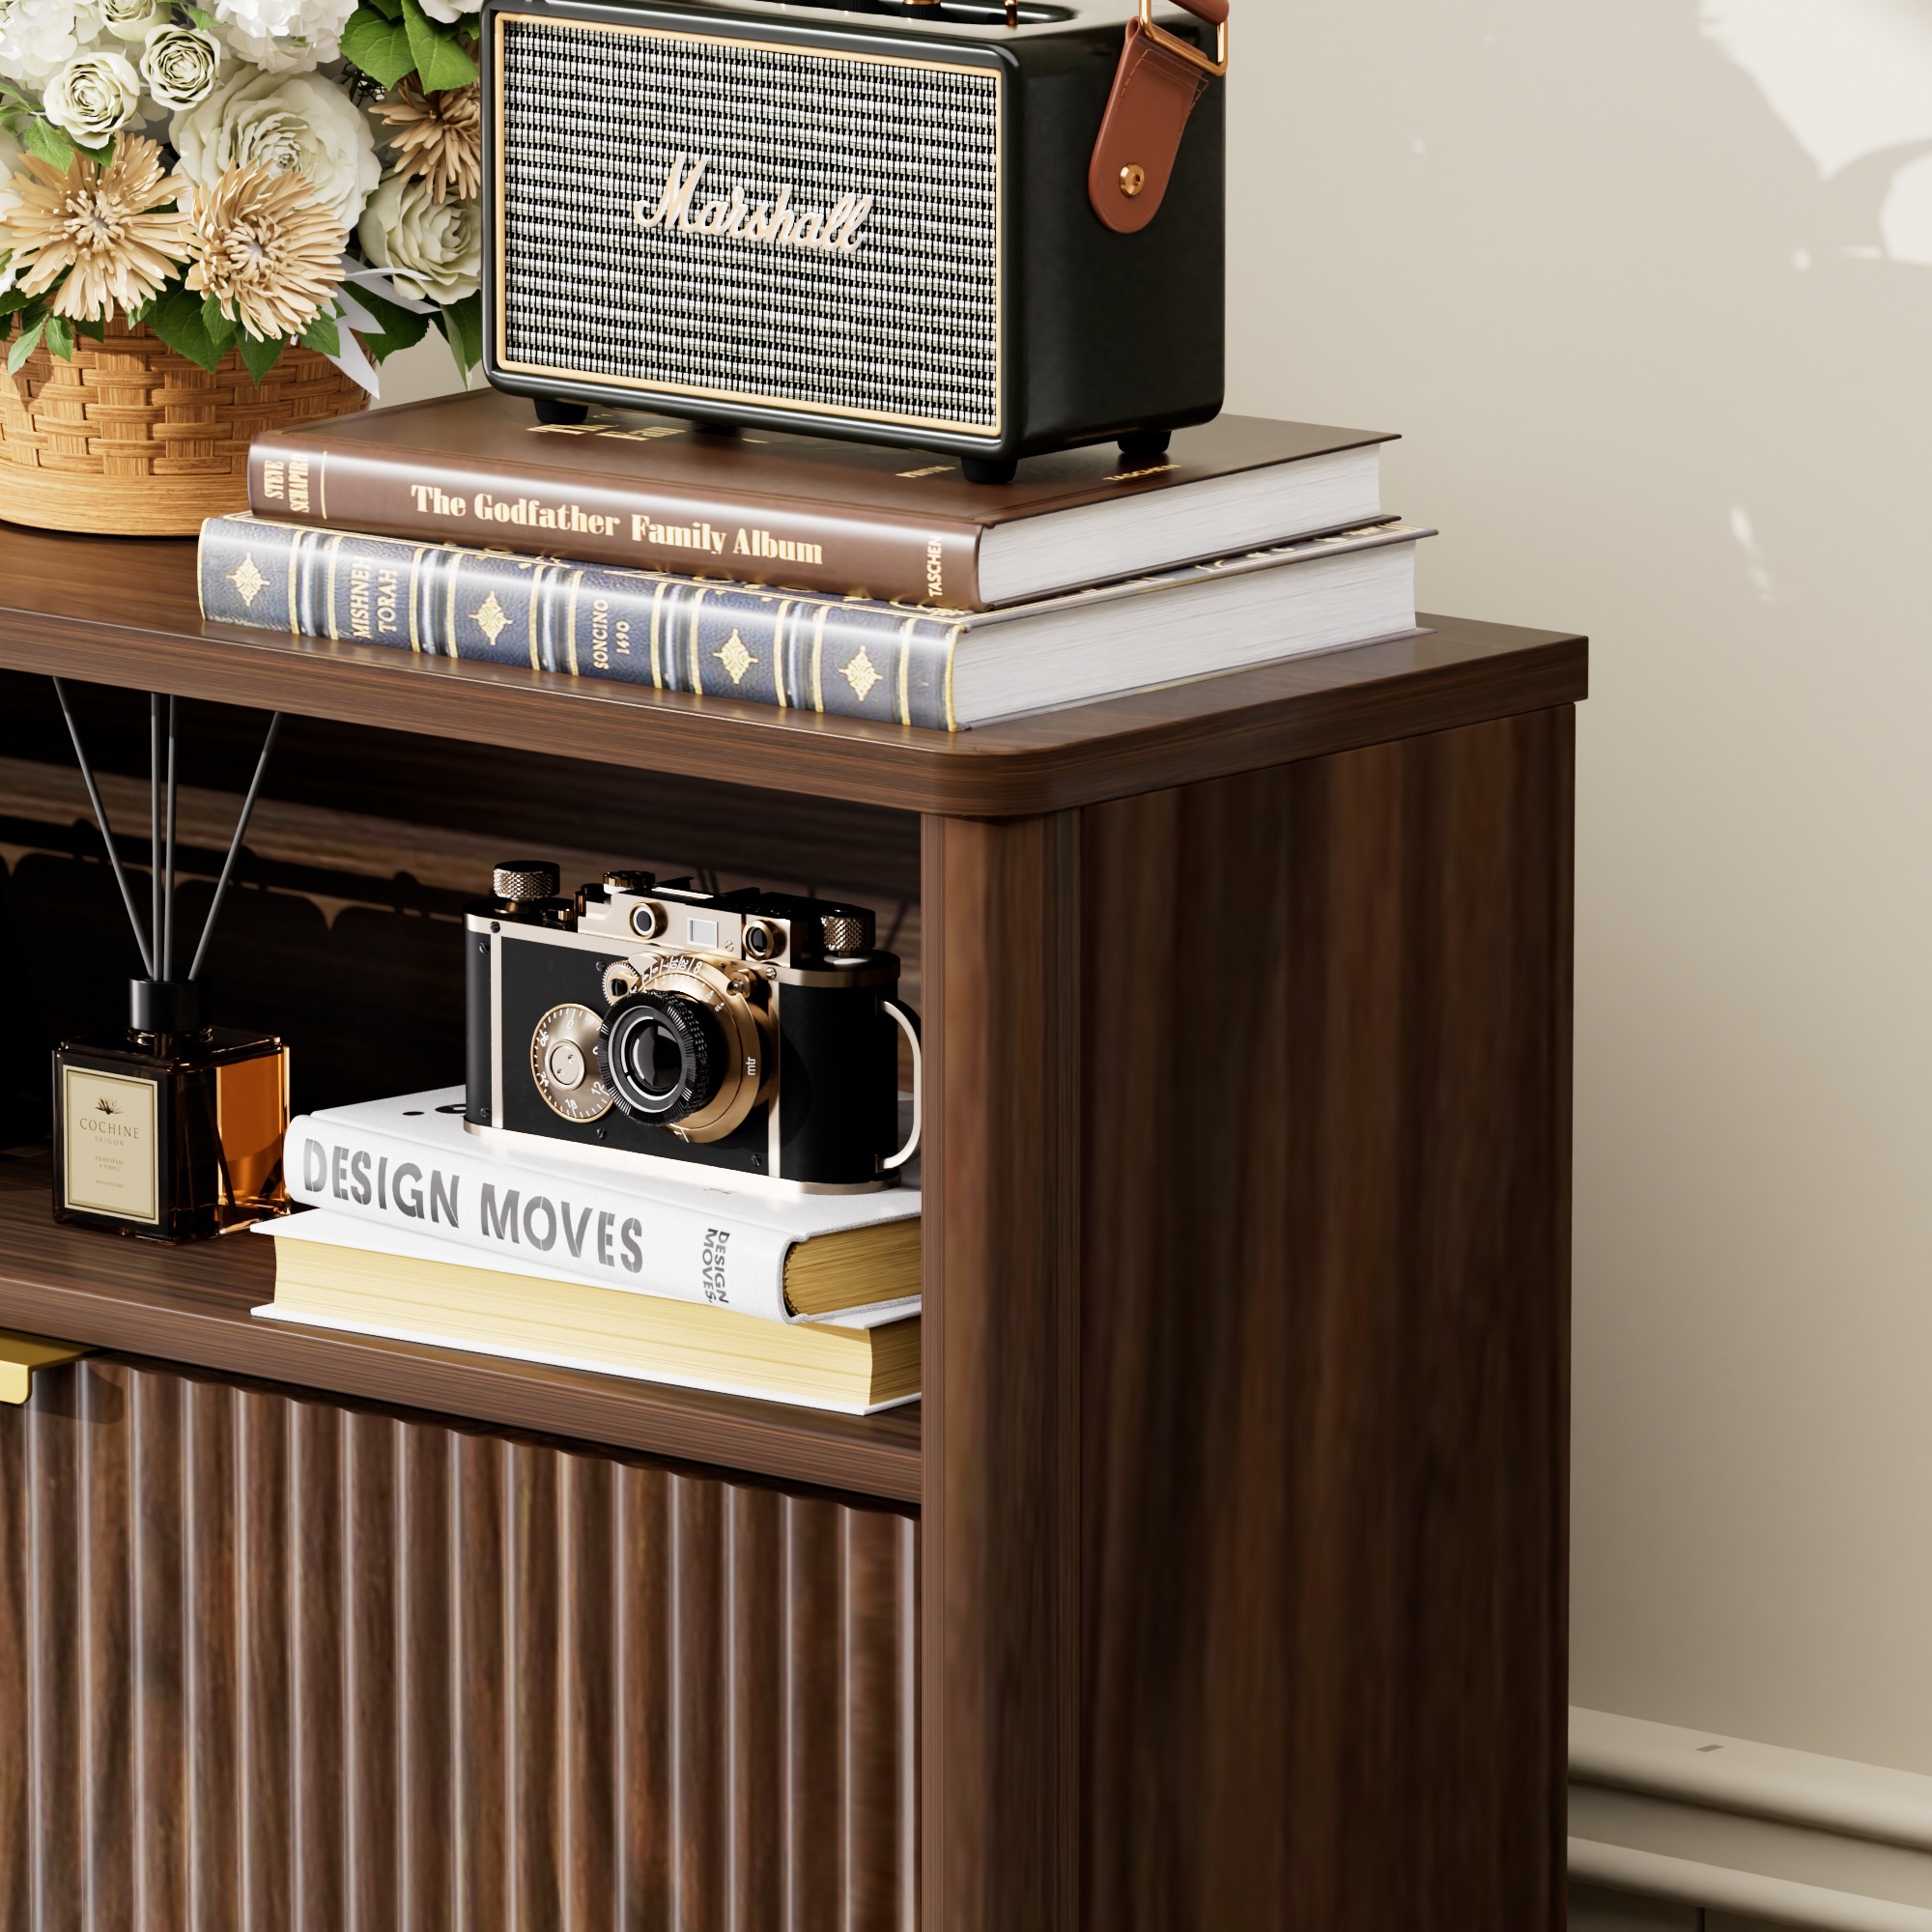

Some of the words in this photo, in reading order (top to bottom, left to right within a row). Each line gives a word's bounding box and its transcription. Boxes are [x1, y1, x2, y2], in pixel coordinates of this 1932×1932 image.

[634, 151, 873, 253] Marshall
[264, 460, 284, 499] STEVE
[288, 453, 310, 513] SCHAPIRO
[411, 484, 467, 517] The
[474, 493, 620, 536] Godfather
[631, 514, 726, 554] Family
[732, 528, 823, 564] Album
[350, 554, 373, 639] MISHNEH
[926, 535, 943, 597] TASCHEN
[376, 568, 398, 634] TORAH
[592, 599, 610, 670] SONCINO
[615, 620, 631, 655] 1490
[591, 1081, 605, 1095] 12
[746, 1056, 756, 1076] mtr
[79, 1118, 139, 1139] COCHINE
[564, 1098, 578, 1110] 18
[95, 1136, 125, 1147] SAIGON
[303, 1138, 460, 1229] DESIGN
[480, 1182, 643, 1273] MOVES
[714, 1231, 730, 1304] DESIGN
